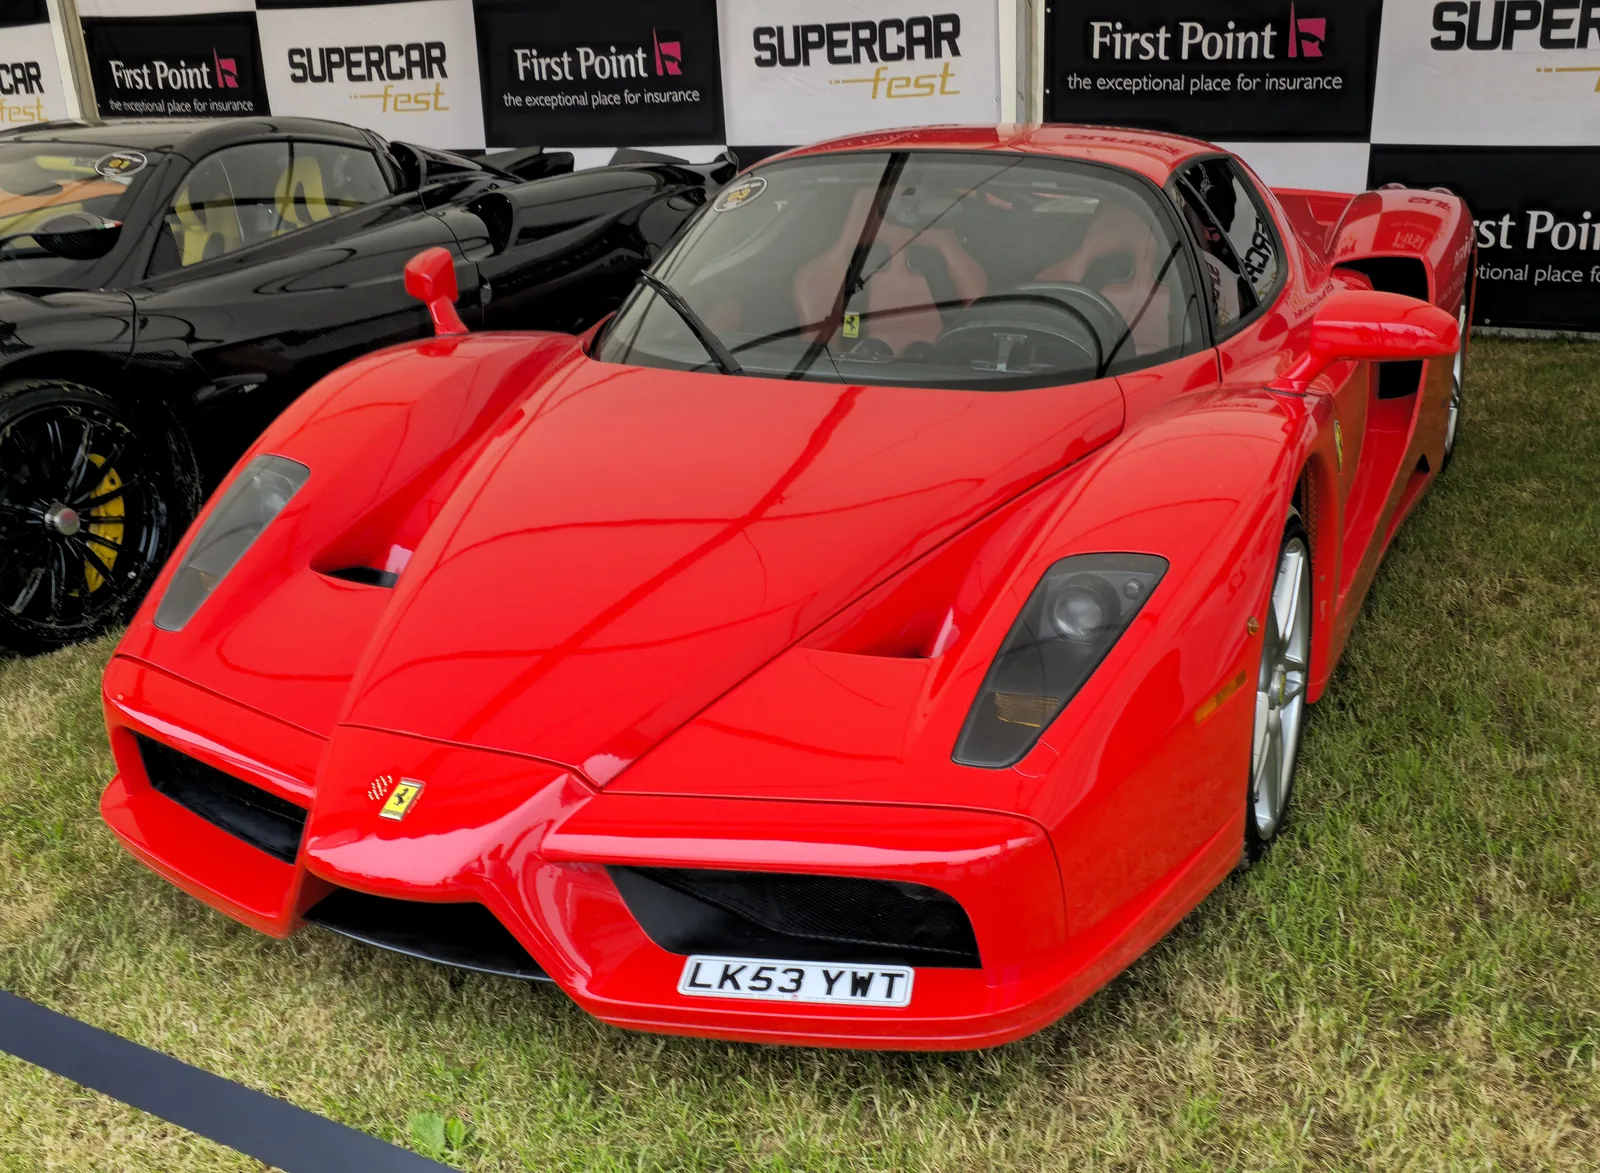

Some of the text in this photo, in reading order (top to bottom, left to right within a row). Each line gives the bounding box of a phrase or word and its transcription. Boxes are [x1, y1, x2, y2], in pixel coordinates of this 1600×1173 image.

[752, 13, 962, 67] SUPERCAR
[1090, 20, 1277, 60] First Point
[108, 59, 212, 90] First Point
[288, 41, 448, 83] SUPERCAR
[514, 45, 648, 81] First Point
[871, 62, 961, 100] fest
[1066, 73, 1343, 95] the exceptional place for insurance
[0, 96, 49, 122] fest
[109, 97, 254, 115] the exceptional place for insurance
[381, 82, 449, 113] fest
[503, 88, 701, 110] the exceptional place for insurance
[1475, 263, 1529, 281] tional
[1534, 264, 1584, 286] place
[688, 962, 905, 999] LK53 YWT
